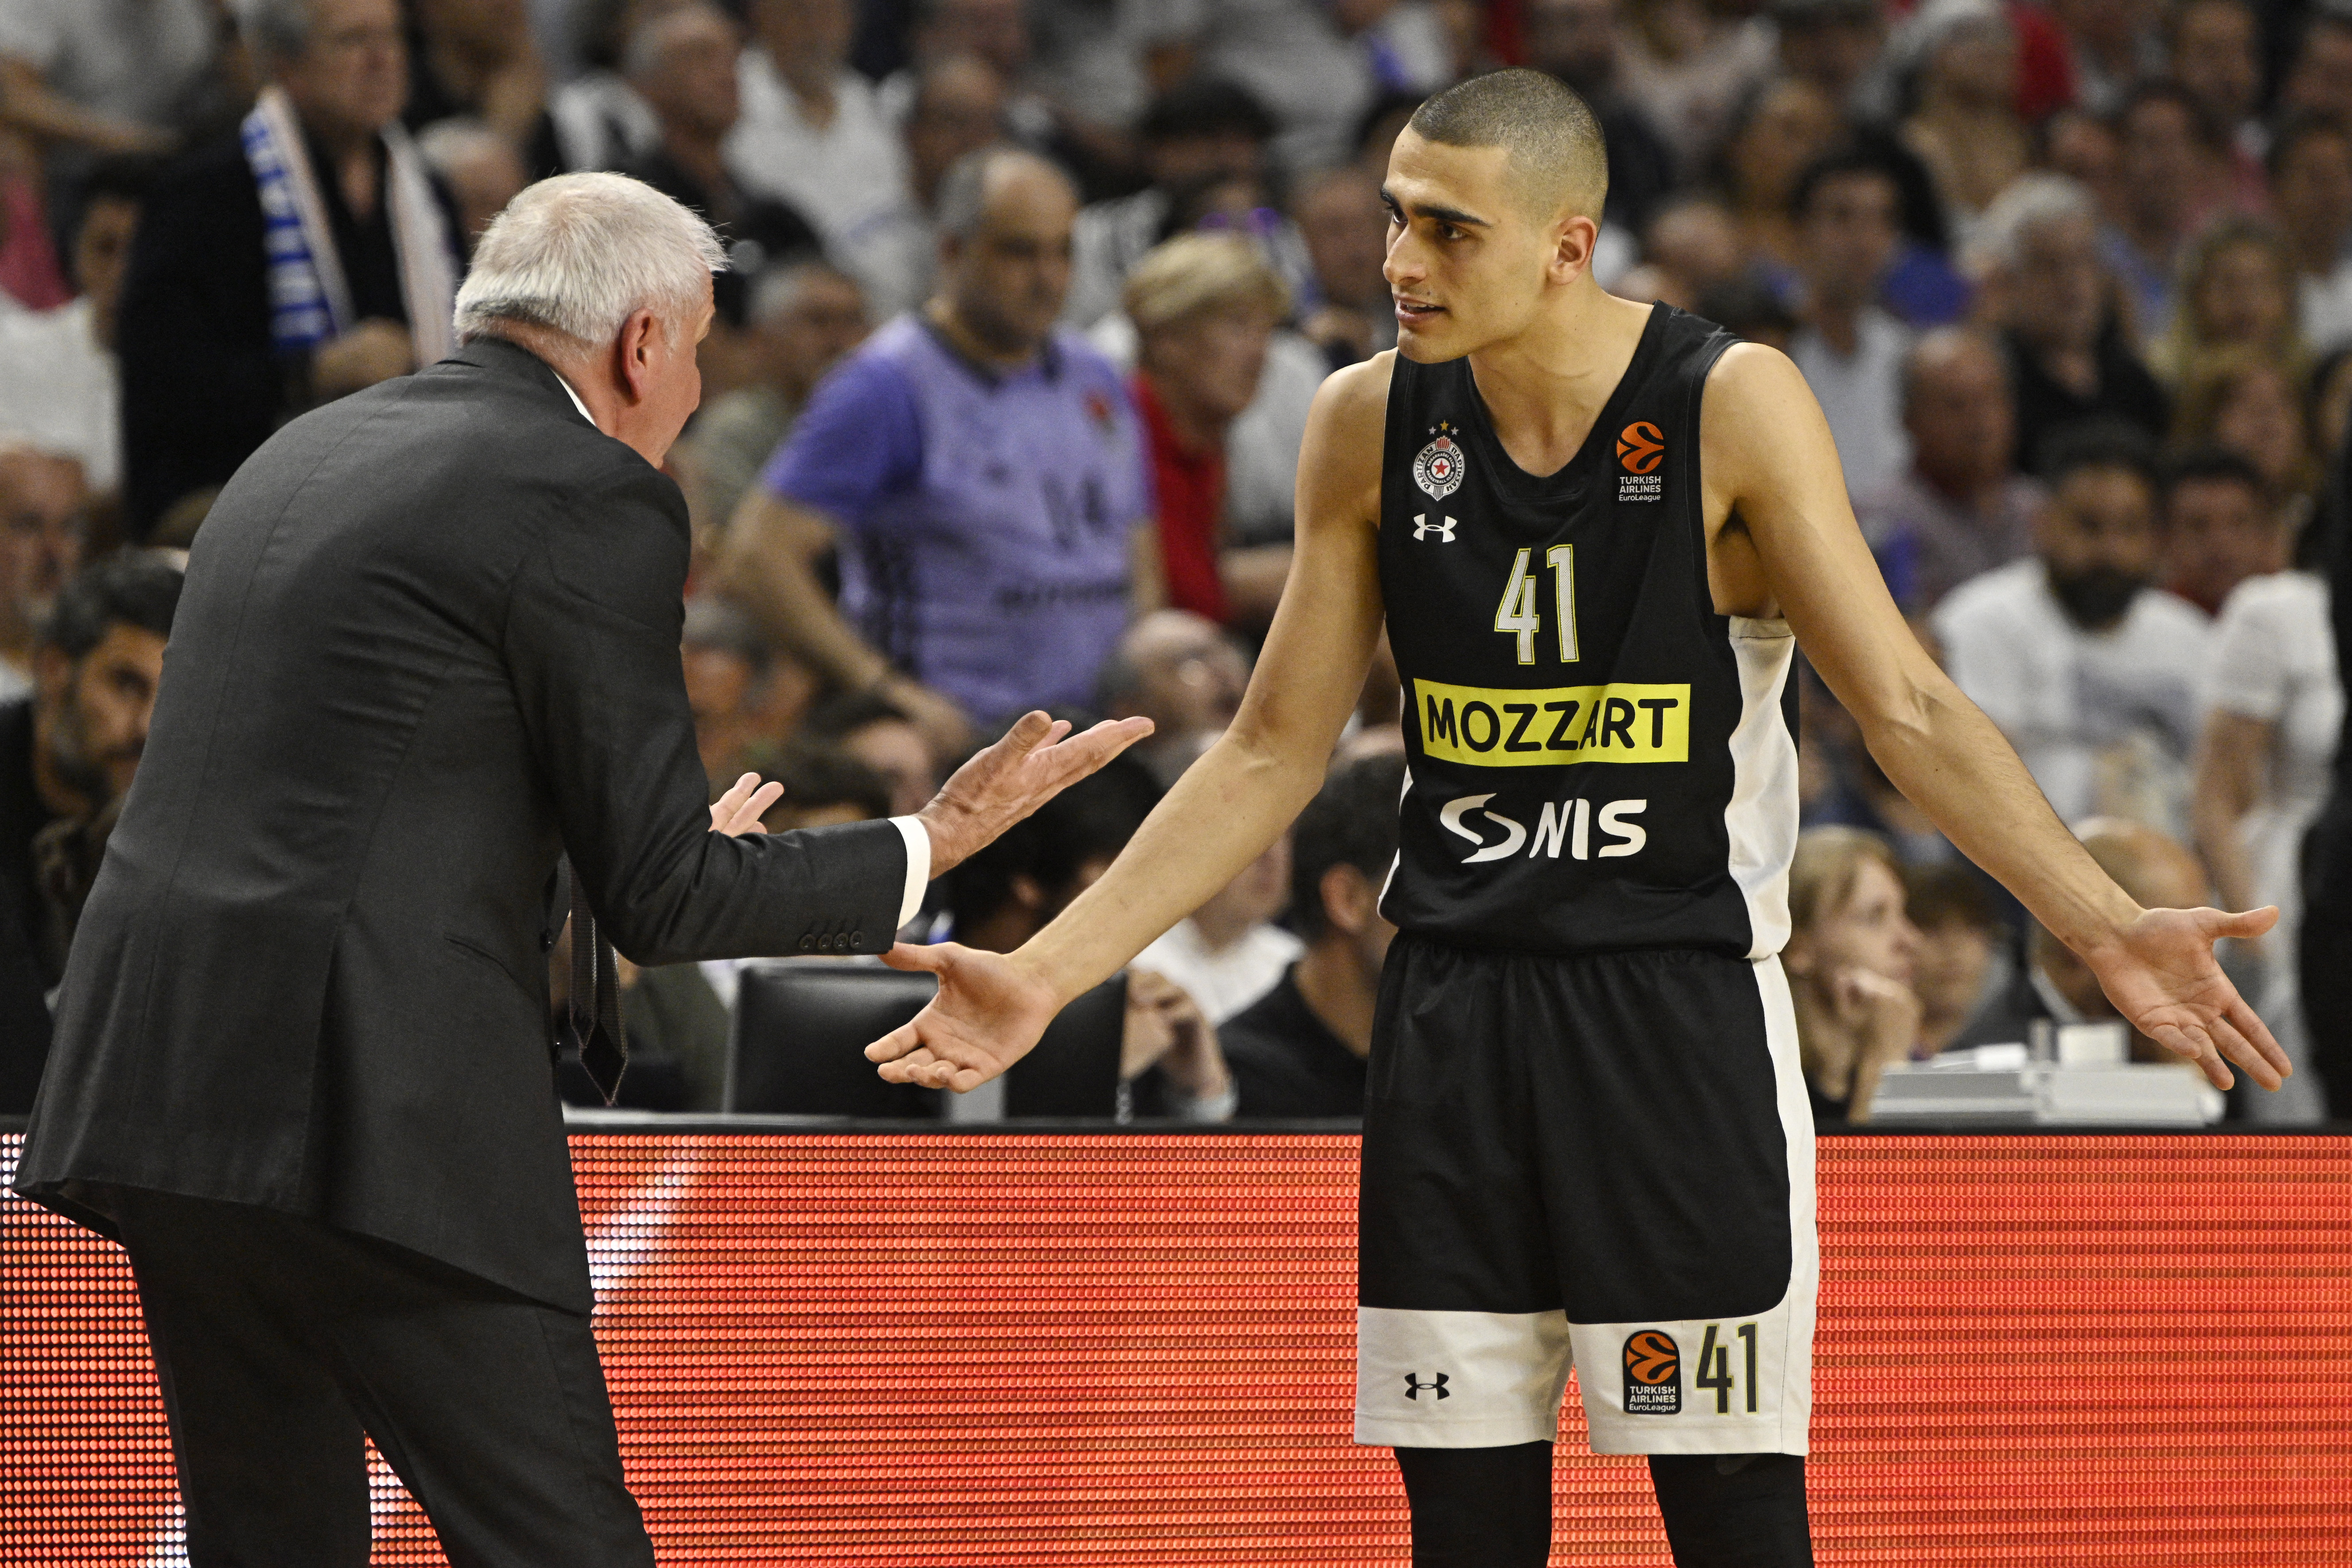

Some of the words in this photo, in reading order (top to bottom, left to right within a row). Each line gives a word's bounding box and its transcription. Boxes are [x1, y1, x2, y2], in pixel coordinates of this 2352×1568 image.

[1427, 452, 1449, 467] KOŠARKAŠKI
[1416, 446, 1434, 490] PARTIZAN
[1446, 447, 1462, 492] ПАРТИЗАН
[1426, 470, 1446, 484] BASKETBALL
[1620, 476, 1661, 484] TURKISH
[1619, 485, 1661, 493] AIRLINES
[1494, 544, 1580, 665] 41
[1427, 693, 1679, 753] MOZZART
[1529, 798, 1647, 860] NIS
[1695, 1322, 1759, 1416] 41
[1630, 1386, 1676, 1394] TURKISH
[1629, 1395, 1676, 1403] AIRLINES
[1629, 1404, 1676, 1412] EuroLeague
